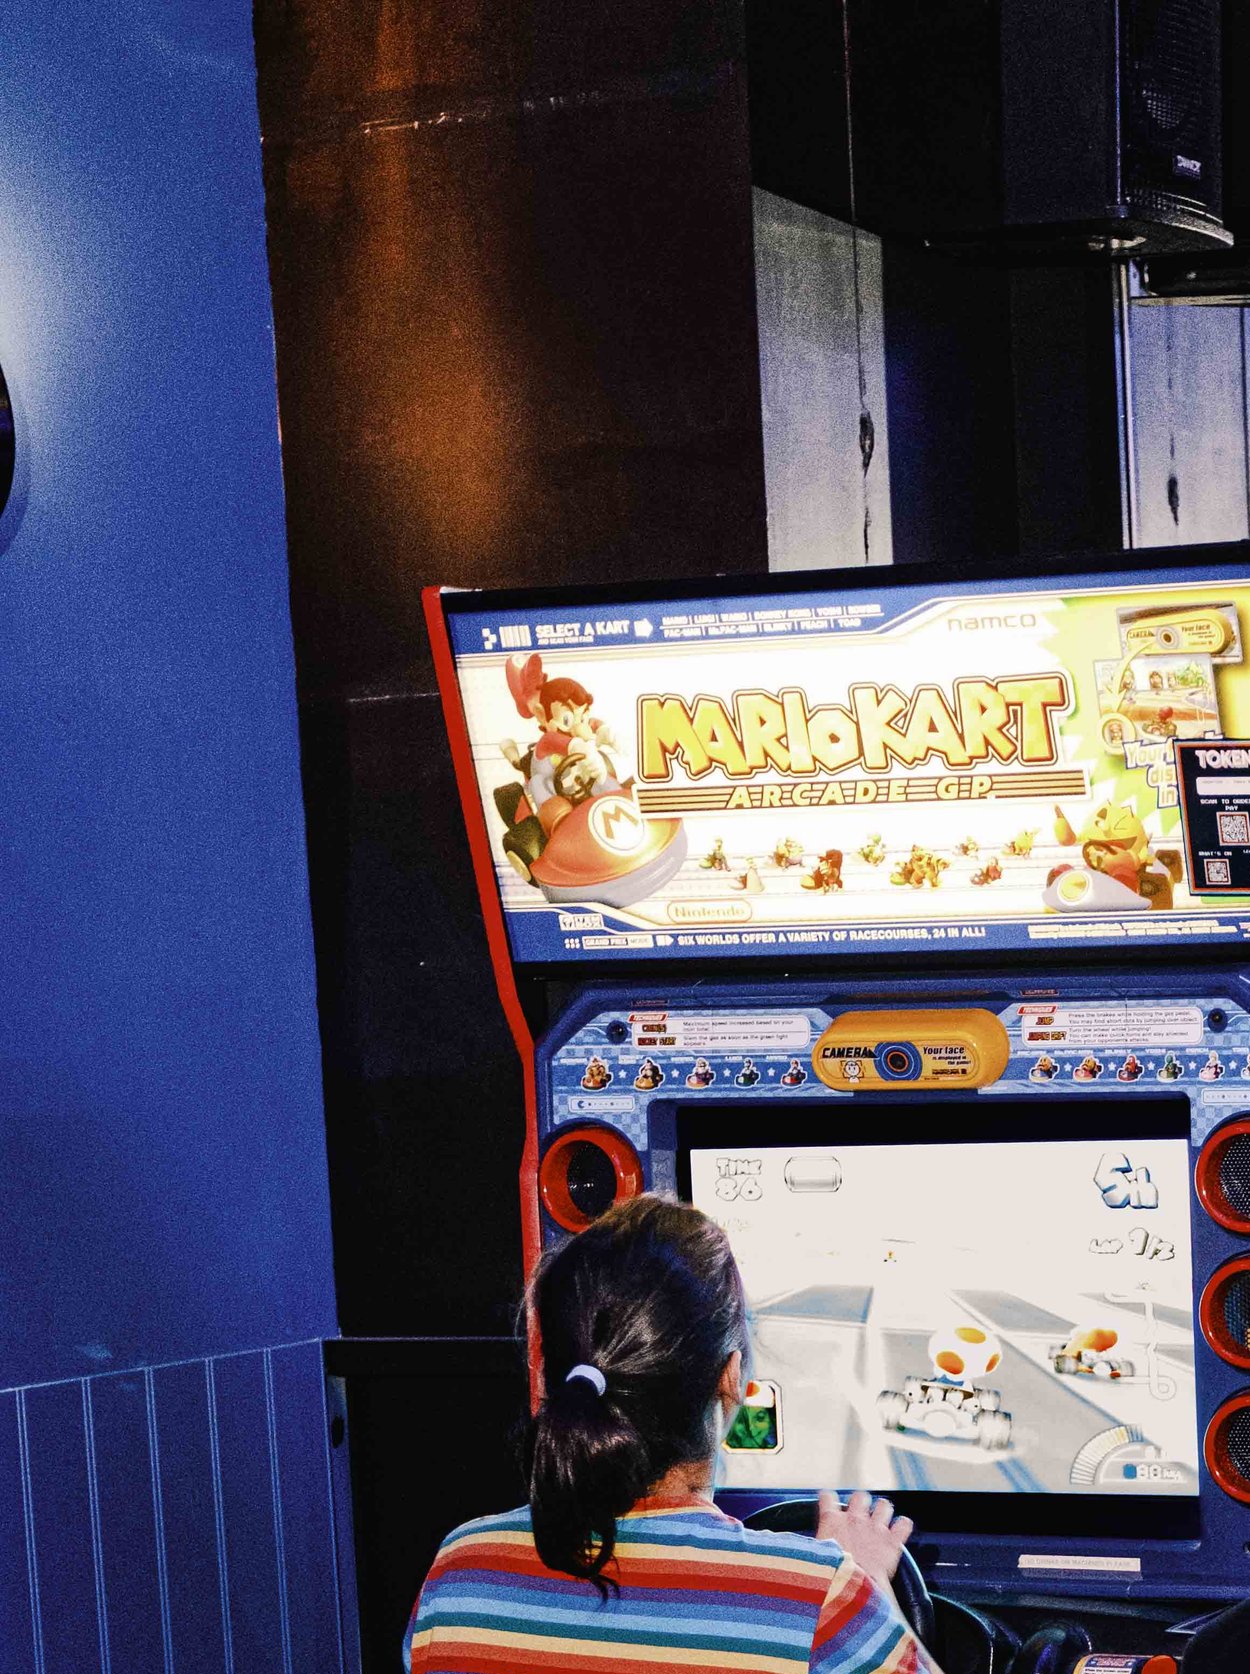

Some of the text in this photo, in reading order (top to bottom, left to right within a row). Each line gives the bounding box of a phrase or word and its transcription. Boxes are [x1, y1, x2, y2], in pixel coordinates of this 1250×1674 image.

[535, 620, 630, 638] SELECT A KART
[948, 613, 1036, 632] namco
[727, 778, 907, 809] ARCADE
[673, 905, 746, 918] Nintendo
[678, 926, 986, 946] SIX WORLDS OFFER A VARIETY OF RACECOURSES, 24 IN ALL!
[822, 1047, 868, 1059] CAMERA
[923, 1046, 965, 1055] Your face
[716, 1158, 762, 1177] TIME
[715, 1176, 763, 1202] 86
